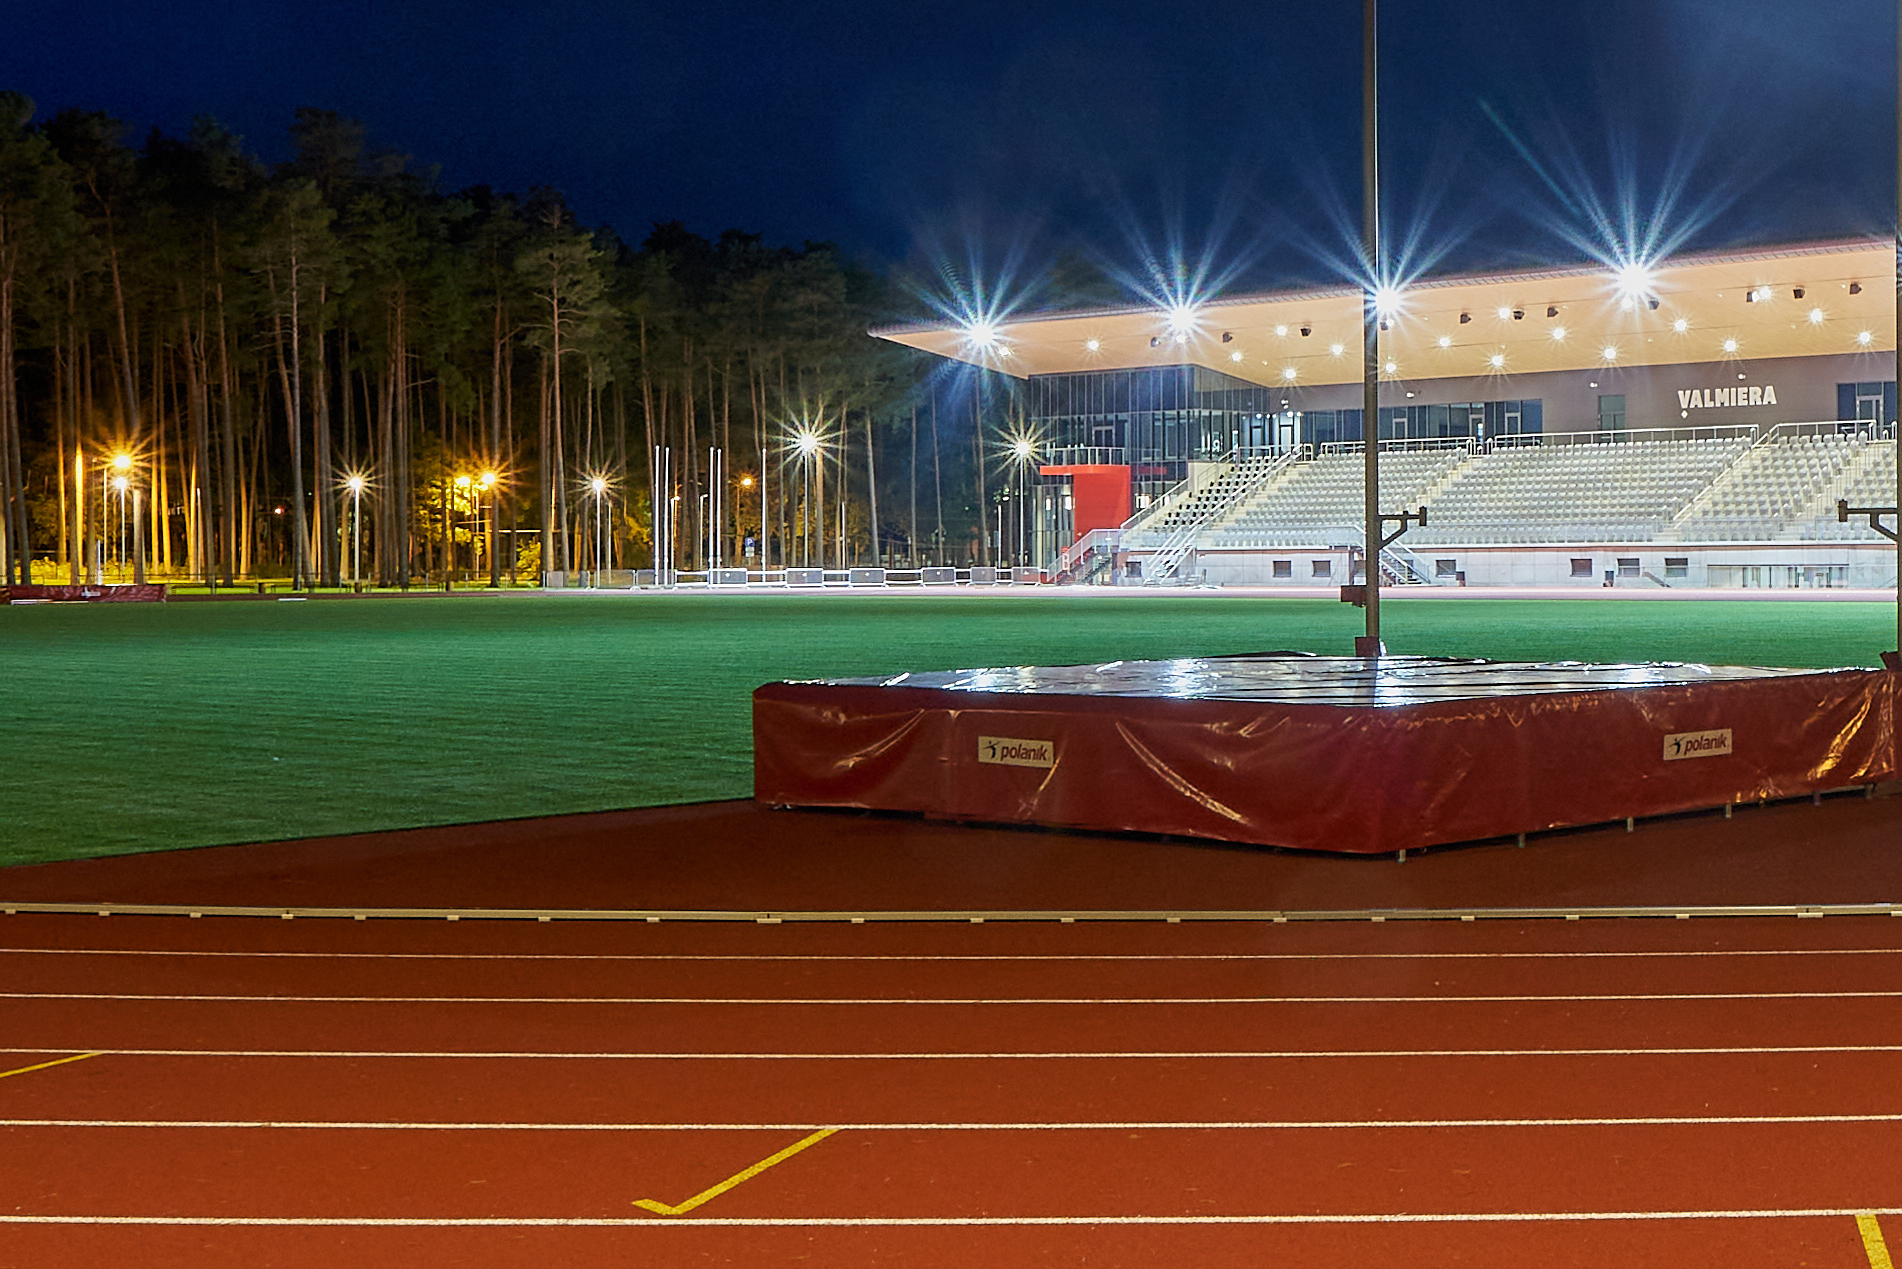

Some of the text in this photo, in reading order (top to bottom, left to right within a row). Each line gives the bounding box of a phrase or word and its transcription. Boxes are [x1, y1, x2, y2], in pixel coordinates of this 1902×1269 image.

[1678, 386, 1777, 409] VALMIERA
[1000, 743, 1047, 761] polanik
[1684, 733, 1727, 756] polanik
